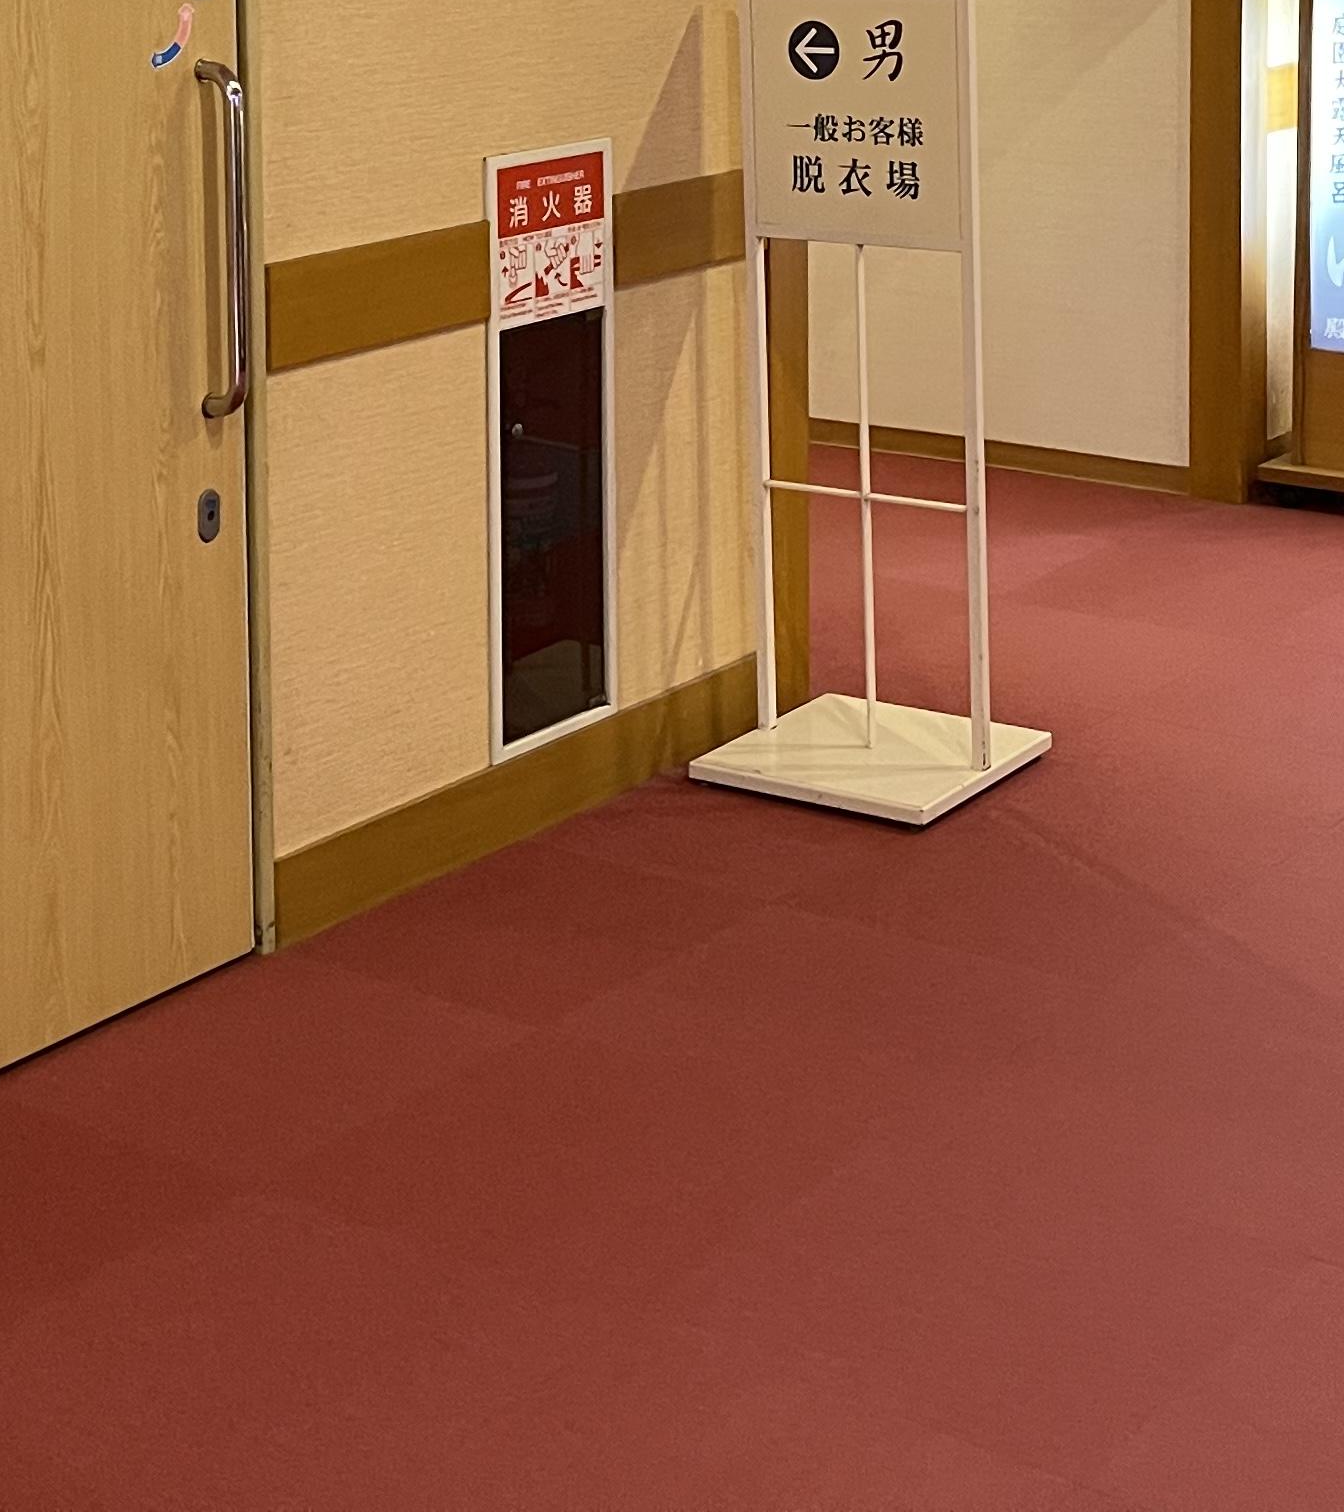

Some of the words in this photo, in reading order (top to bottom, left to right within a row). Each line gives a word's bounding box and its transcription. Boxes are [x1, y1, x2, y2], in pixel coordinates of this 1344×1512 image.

[862, 19, 906, 82] 男
[786, 112, 926, 148] 一般お客様
[791, 154, 922, 200] 脱衣場
[509, 184, 593, 229] 消火器
